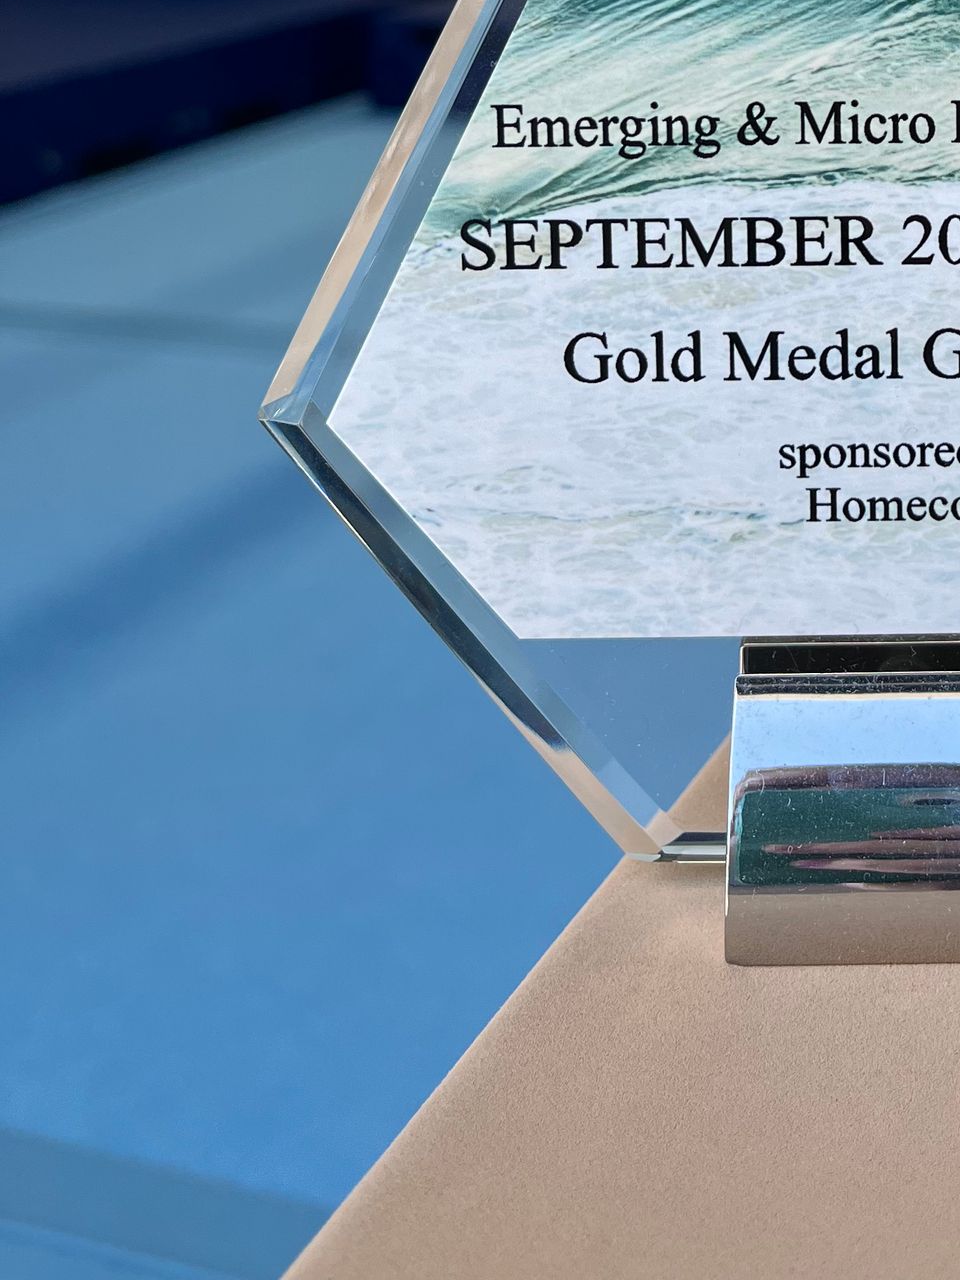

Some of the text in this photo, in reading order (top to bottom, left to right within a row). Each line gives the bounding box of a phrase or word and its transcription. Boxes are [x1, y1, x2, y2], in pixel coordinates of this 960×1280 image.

[490, 101, 721, 160] Emerging
[736, 101, 780, 146] &
[795, 99, 936, 145] Micro
[459, 215, 884, 271] SEPTEMBER
[563, 330, 706, 384] Gold
[722, 327, 904, 381] Medal
